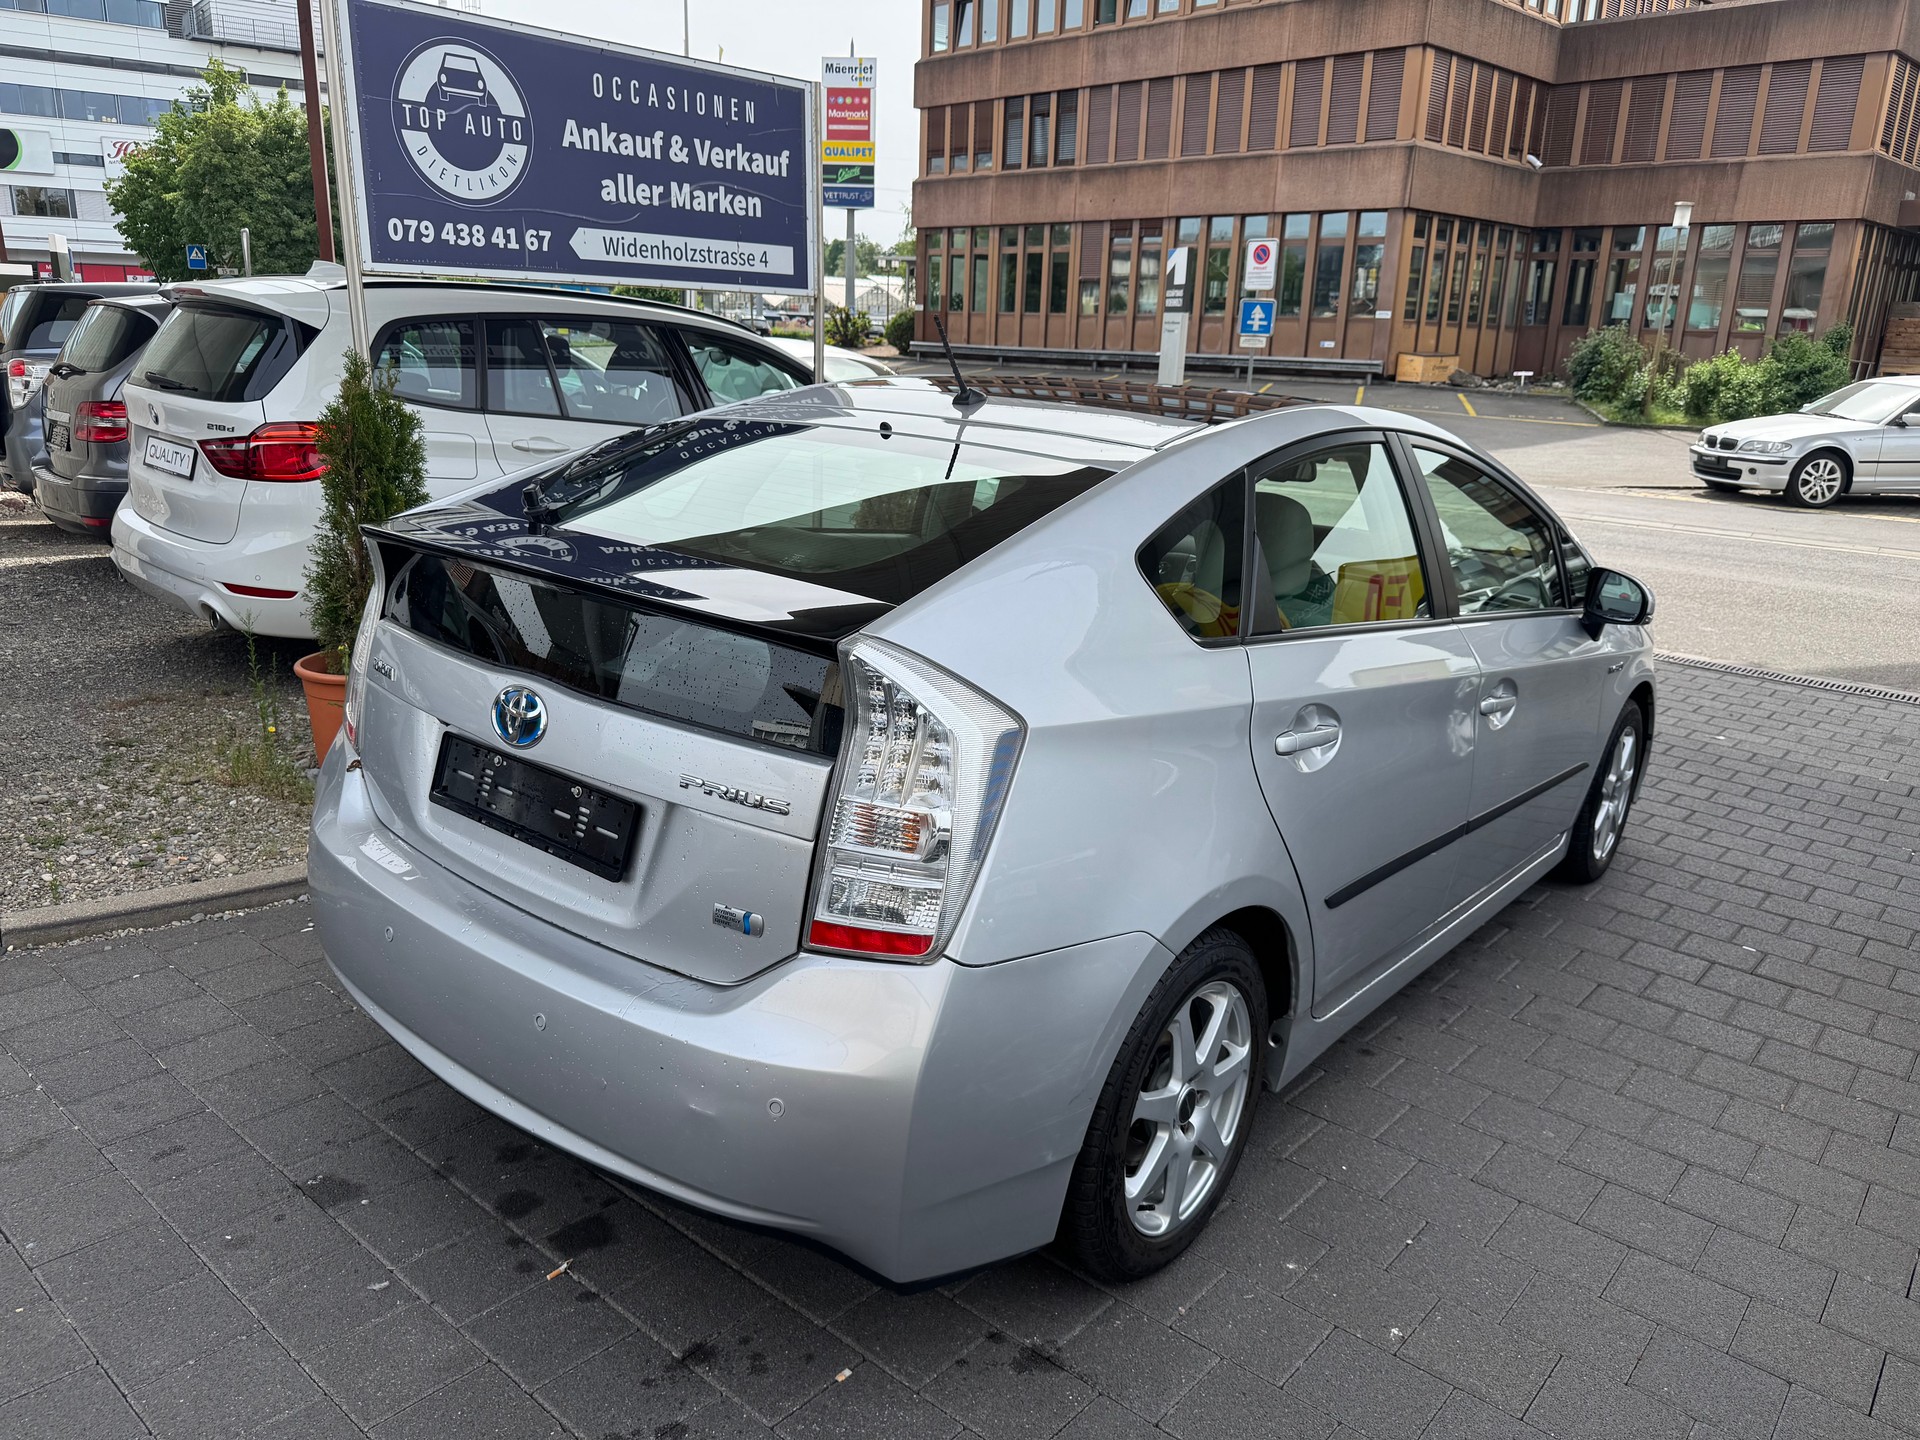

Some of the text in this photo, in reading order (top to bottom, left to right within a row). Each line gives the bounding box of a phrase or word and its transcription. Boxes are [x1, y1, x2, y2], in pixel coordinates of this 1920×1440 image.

[825, 62, 873, 74] Mäenriet
[851, 74, 873, 82] Center
[592, 72, 756, 125] OCCASIONEN
[401, 103, 524, 142] TOP AUTO
[562, 118, 664, 164] Ankauf
[669, 134, 689, 164] &
[693, 137, 790, 178] Verkauf
[824, 146, 873, 157] QUALIPET
[417, 145, 519, 192] DIETLIKON
[600, 173, 762, 218] aller Marken
[387, 217, 552, 252] 079 438 41 67
[602, 234, 770, 269] Widenholzstrasse 4
[679, 773, 791, 816] PRIUS
[715, 907, 737, 918] HYBRID
